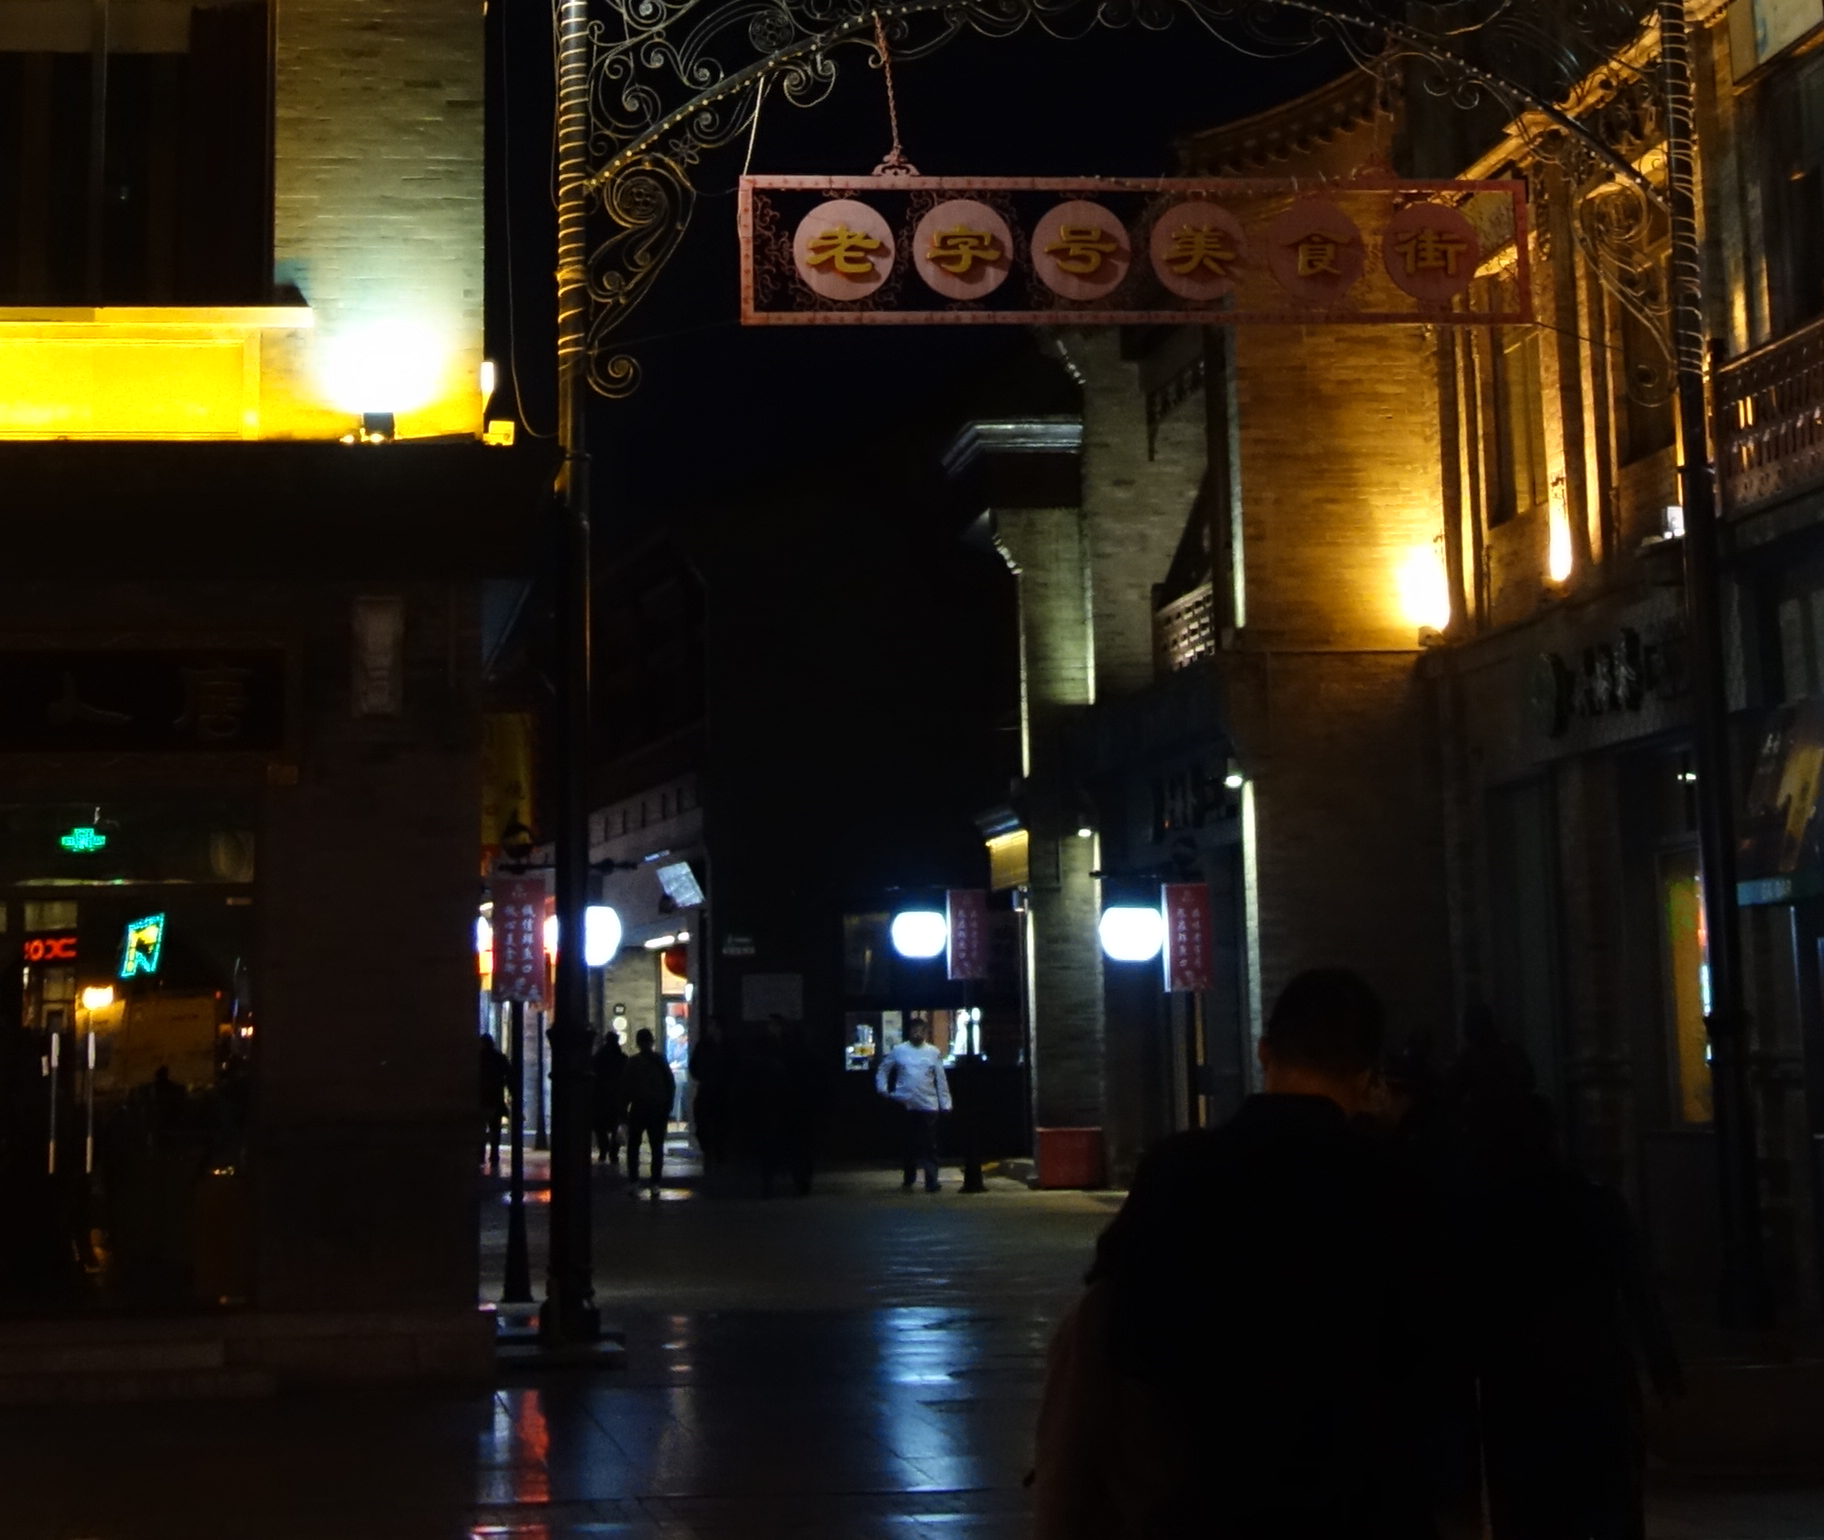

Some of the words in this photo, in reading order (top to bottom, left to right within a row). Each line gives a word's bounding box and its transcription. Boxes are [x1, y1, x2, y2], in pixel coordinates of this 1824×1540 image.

[806, 225, 1464, 278] 老字号美食街
